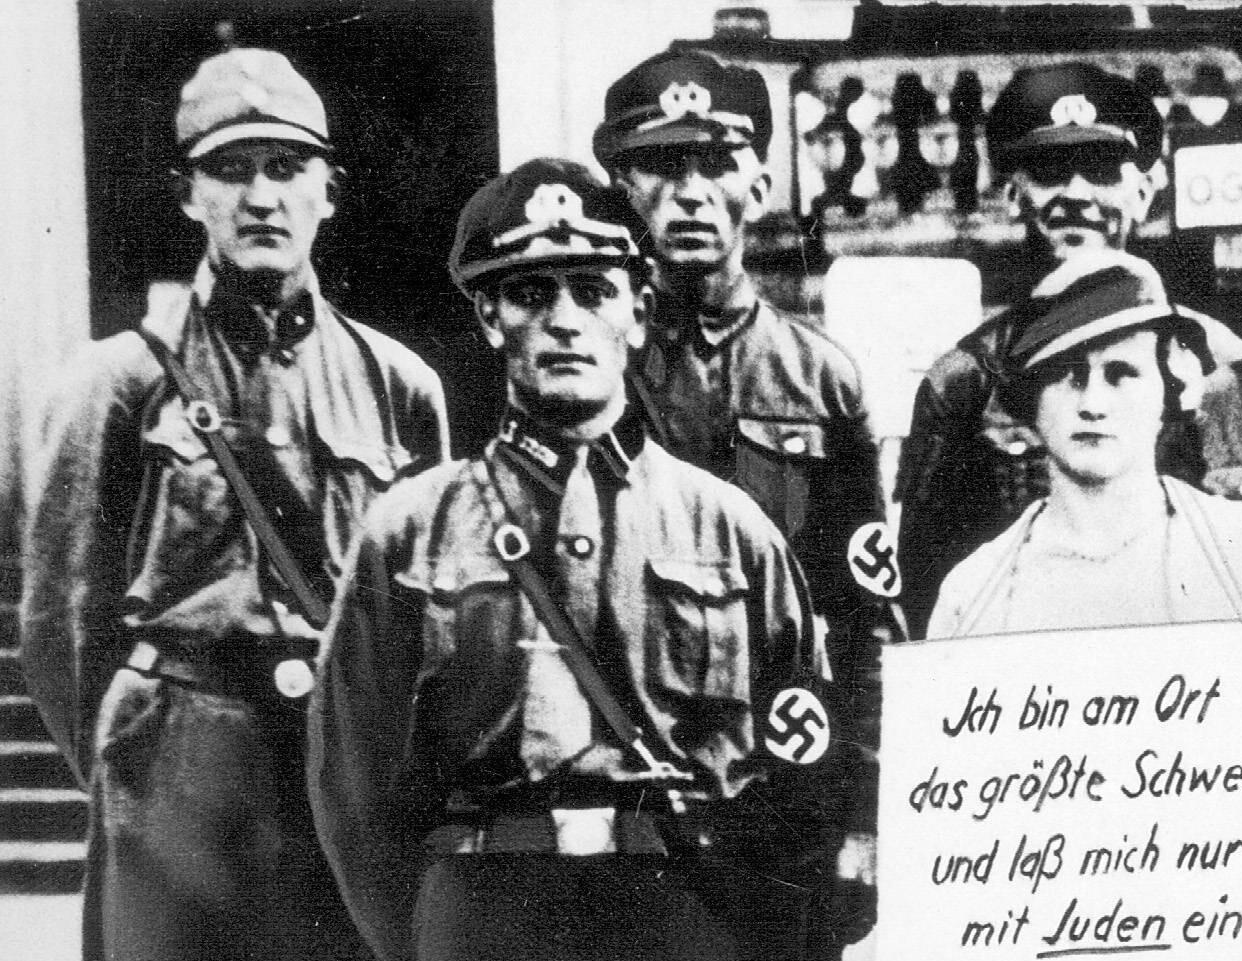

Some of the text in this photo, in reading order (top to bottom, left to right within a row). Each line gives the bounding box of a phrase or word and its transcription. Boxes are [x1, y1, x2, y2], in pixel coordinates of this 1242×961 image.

[1018, 685, 1070, 730] bin
[1082, 695, 1140, 727] am
[1154, 674, 1221, 724] Ort
[909, 766, 968, 814] das
[972, 754, 1106, 821] größte
[931, 839, 1000, 886] und
[1008, 833, 1066, 895] laß
[1079, 823, 1160, 875] mich
[961, 905, 1030, 947] mit
[1036, 898, 1172, 959] Juden
